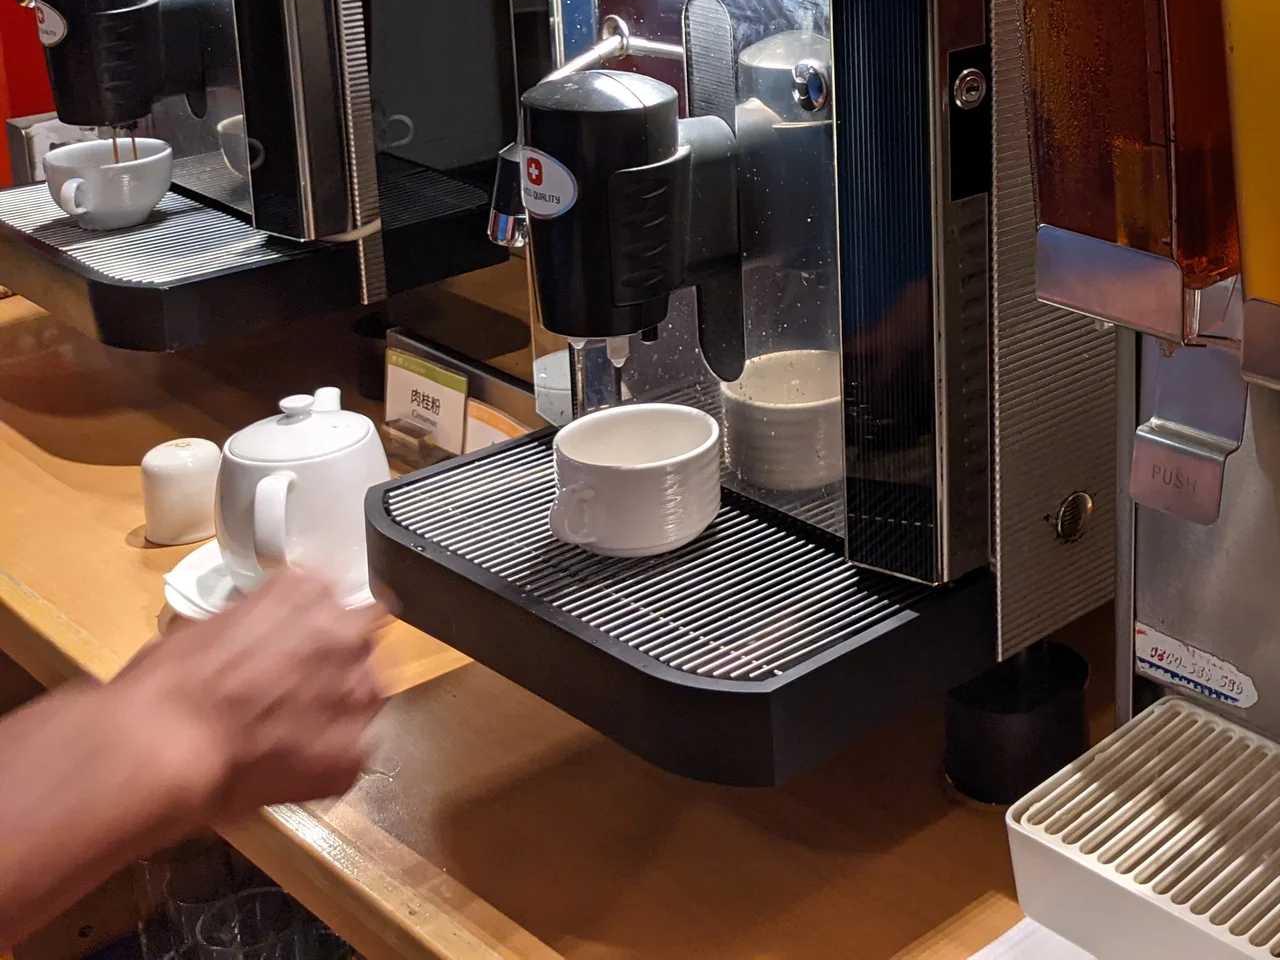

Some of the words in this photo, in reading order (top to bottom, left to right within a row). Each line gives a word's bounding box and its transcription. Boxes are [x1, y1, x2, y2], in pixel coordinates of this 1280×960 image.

[533, 191, 560, 204] QUALITY
[410, 388, 441, 416] 肉桂粉
[1152, 464, 1197, 494] PUSH
